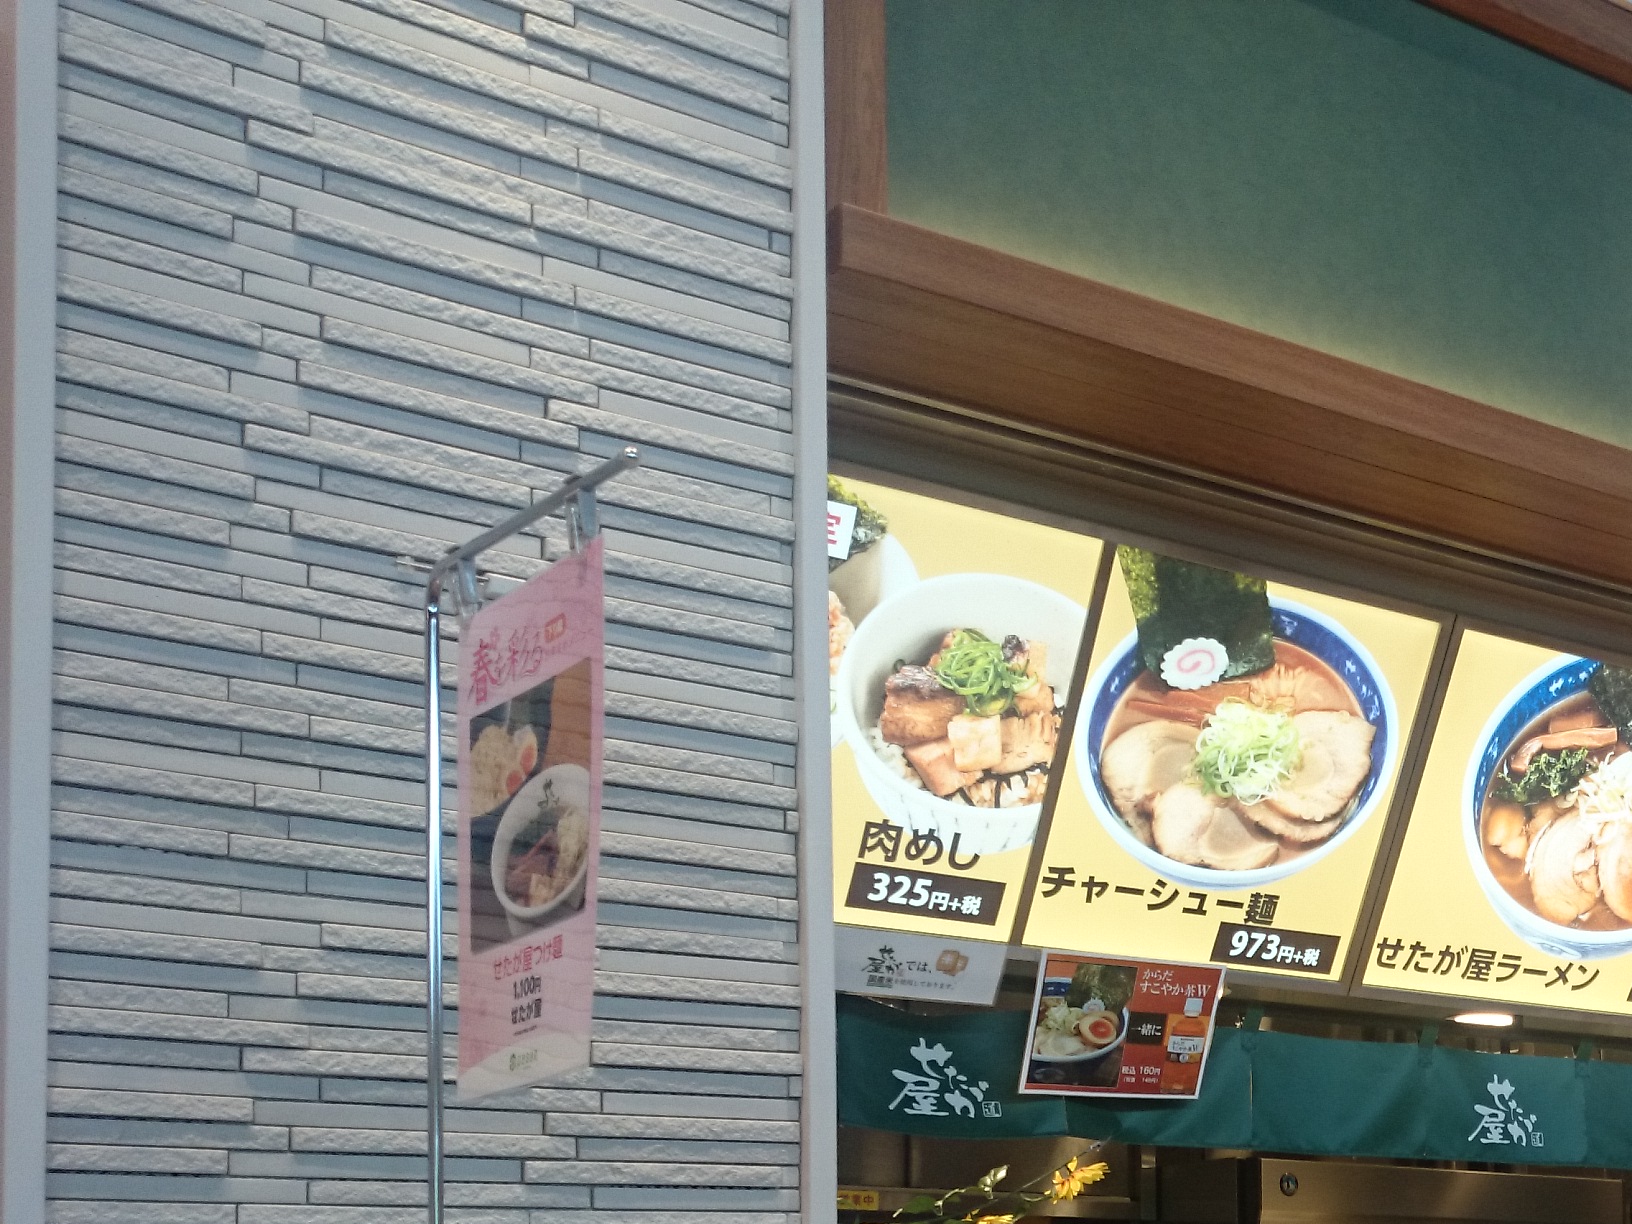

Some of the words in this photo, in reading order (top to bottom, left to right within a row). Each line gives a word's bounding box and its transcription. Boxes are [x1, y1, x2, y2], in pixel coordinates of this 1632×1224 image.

[857, 819, 981, 872] 肉めし
[866, 870, 982, 918] 325円+税
[1041, 865, 1281, 926] チャーシュー麺
[1229, 930, 1322, 968] 973円+税
[1374, 935, 1601, 993] せたが屋ラーメン
[1139, 980, 1211, 998] すこやか茶W
[1143, 968, 1174, 982] からだ
